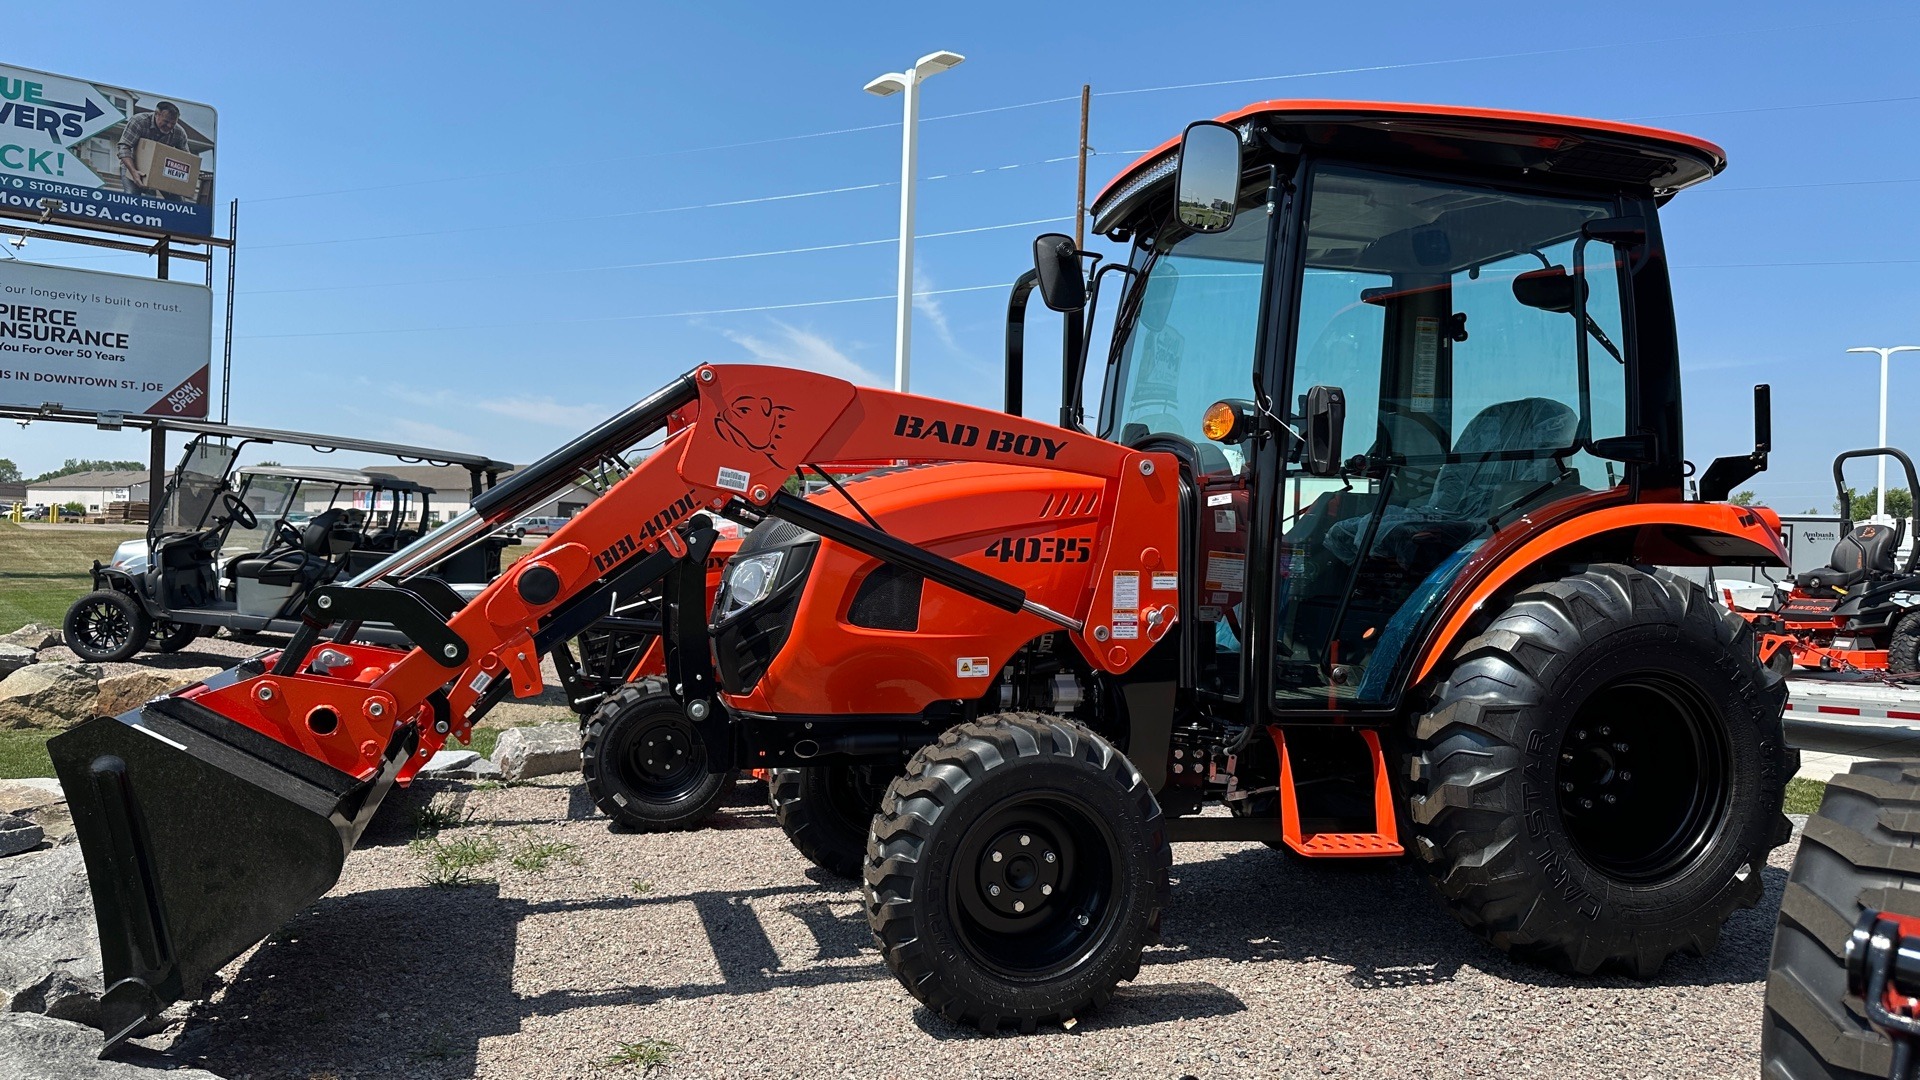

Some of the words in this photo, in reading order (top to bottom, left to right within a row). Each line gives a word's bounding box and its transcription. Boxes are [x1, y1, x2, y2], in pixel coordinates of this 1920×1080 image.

[0, 144, 65, 176] CK!
[167, 169, 185, 179] HEAVY
[30, 181, 88, 198] STORAGE
[107, 194, 138, 206] JUNK
[141, 199, 197, 215] REMOVAL
[5, 286, 26, 294] our
[31, 286, 87, 303] longevity
[105, 295, 131, 307] built
[135, 301, 149, 309] on
[153, 302, 182, 313] trust.
[1, 321, 129, 349] NSURANCE
[23, 344, 42, 354] For
[45, 346, 74, 357] Over
[77, 349, 92, 359] 50
[95, 351, 125, 362] Years
[16, 371, 29, 381] IN
[34, 373, 117, 388] DOWNTOWN
[121, 380, 138, 390] ST.
[141, 382, 164, 393] JOE
[167, 381, 194, 405] NOW
[172, 387, 204, 413] OPEN!
[894, 415, 980, 447] BAD
[986, 430, 1068, 460] BOY
[1803, 531, 1834, 542] Ambush
[984, 537, 1092, 563] 4035
